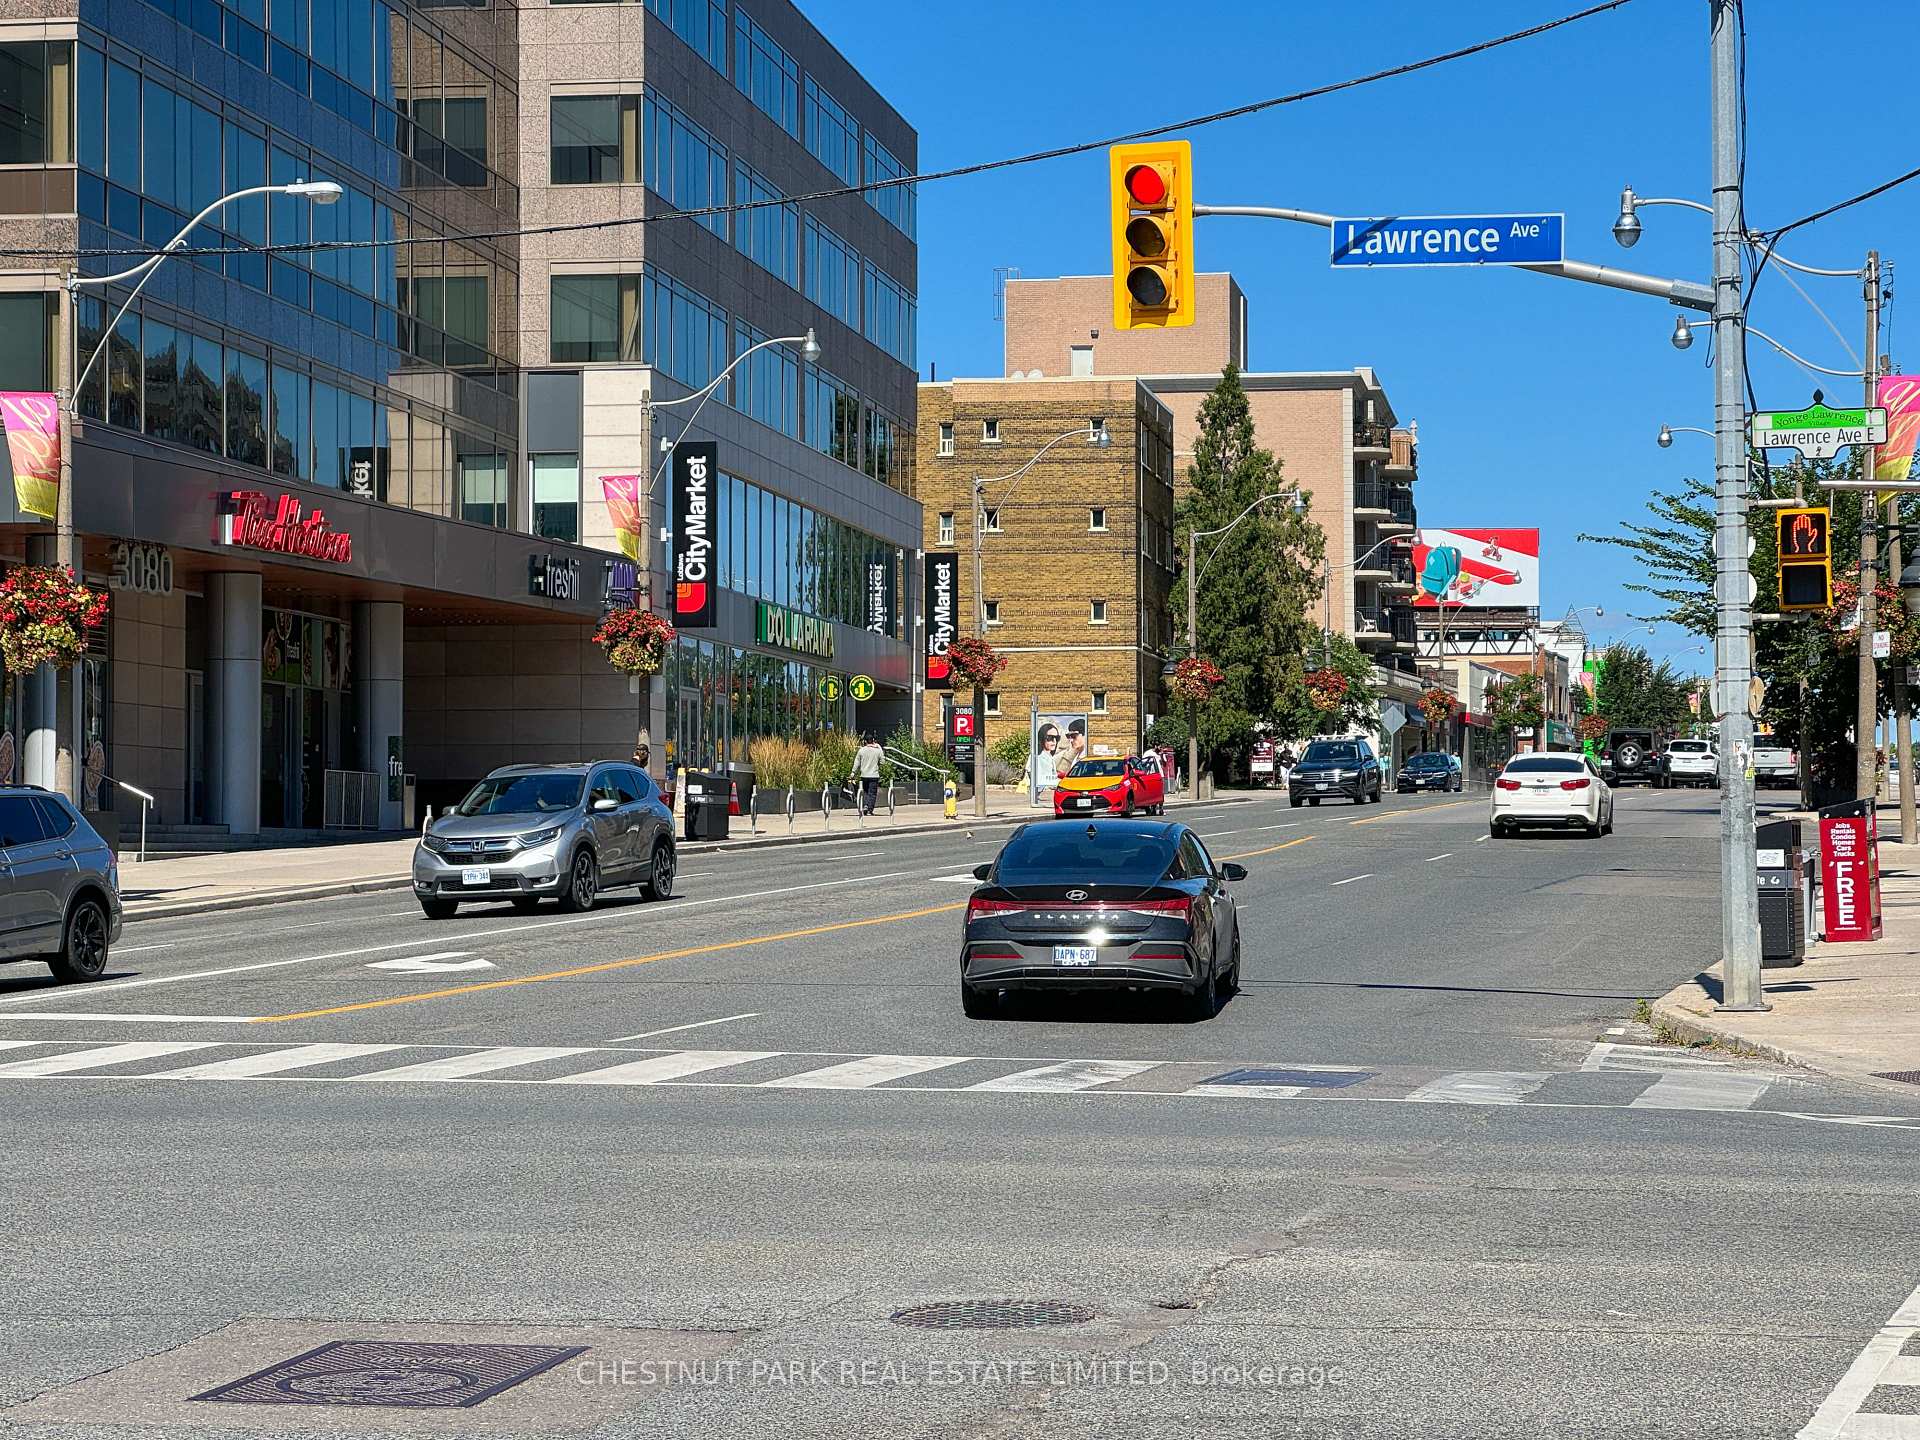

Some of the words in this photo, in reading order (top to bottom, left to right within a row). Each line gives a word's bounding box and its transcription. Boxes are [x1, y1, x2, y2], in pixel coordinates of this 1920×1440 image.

[1348, 224, 1500, 255] Lawrence
[1509, 221, 1540, 238] Ave
[1763, 430, 1831, 446] Lawrence
[1837, 428, 1862, 443] Ave
[1867, 426, 1874, 441] E
[1776, 413, 1809, 427] Yonge
[1812, 410, 1864, 425] Lawrence
[273, 494, 352, 566] Hortons
[685, 456, 712, 581] CityMarket
[116, 543, 174, 597] 3080
[546, 553, 581, 601] freshii
[767, 605, 835, 659] DOLLARAMA
[934, 562, 955, 656] CityMarket
[956, 718, 968, 732] P
[1836, 861, 1856, 926] FREE
[1080, 948, 1095, 960] 687
